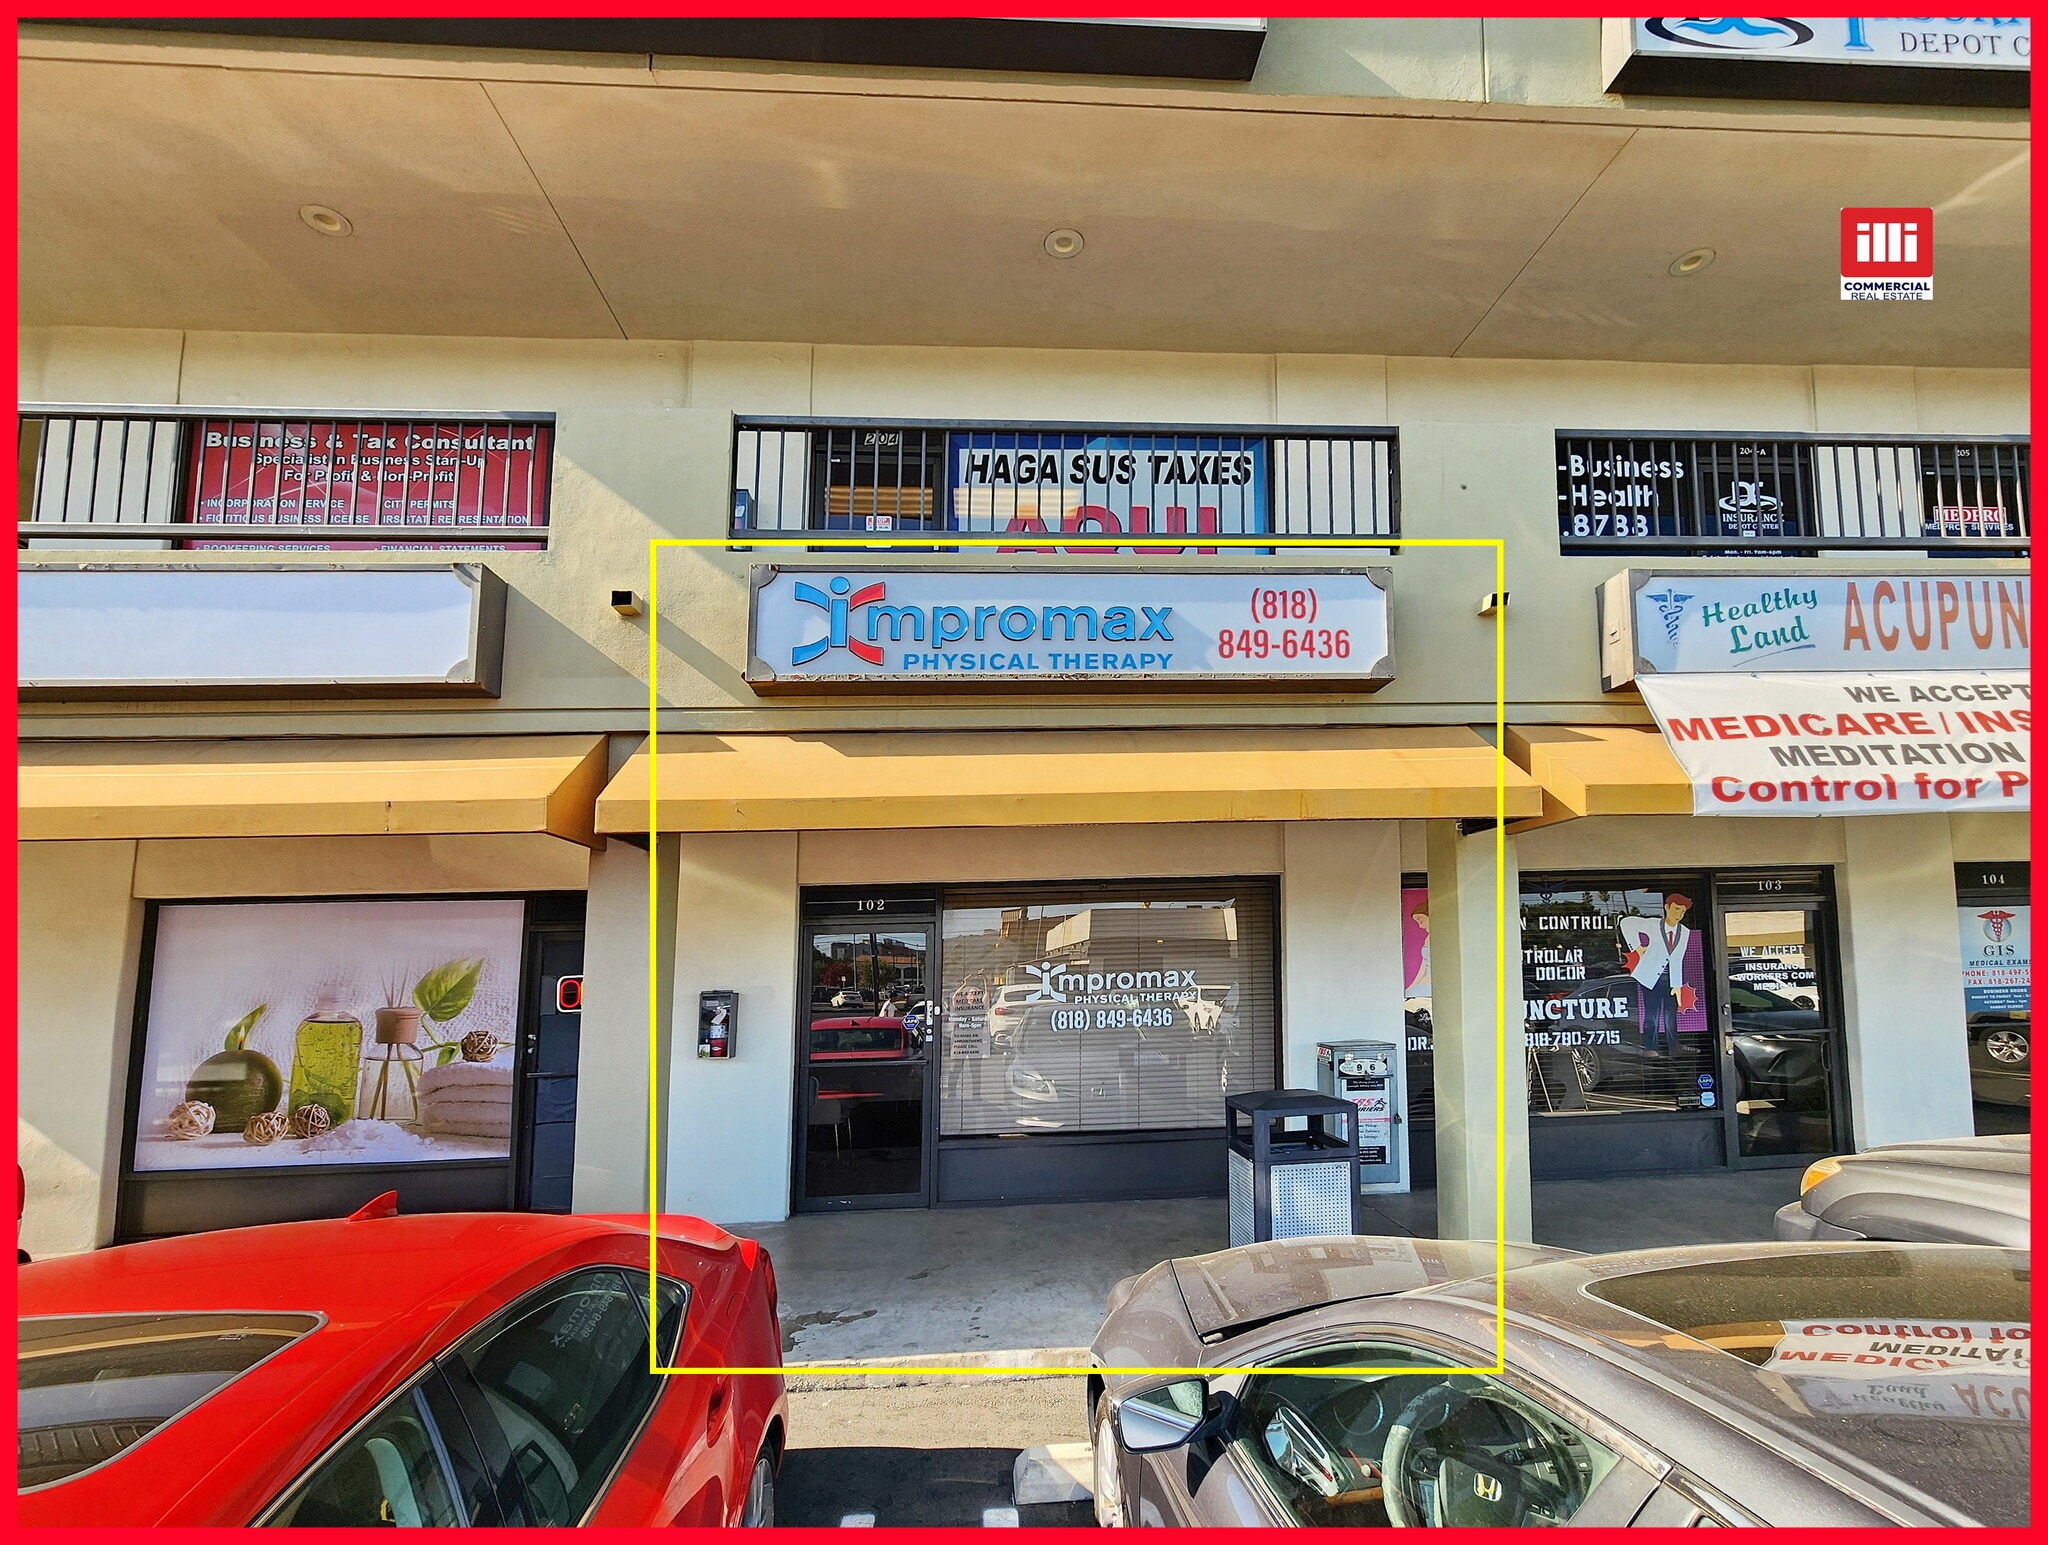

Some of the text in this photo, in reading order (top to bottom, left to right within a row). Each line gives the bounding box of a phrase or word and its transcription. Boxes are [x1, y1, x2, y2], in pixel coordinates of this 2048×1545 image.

[1900, 31, 2001, 55] DEPOT
[206, 432, 317, 449] Busness
[864, 433, 899, 446] 204
[256, 453, 327, 466] Speciaist
[1739, 447, 1766, 456] 20-A
[964, 453, 1252, 486] HAGA SUS TAXES
[1252, 587, 1318, 624] (818)
[1701, 580, 2029, 651] Healthy ACUPUN
[1730, 615, 1811, 654] Land
[1218, 629, 1351, 659] 849-6436
[903, 653, 1174, 670] PHYSICAL THERAPY
[1843, 686, 1901, 704] WE
[1666, 711, 1937, 742] MEDICARE
[1768, 741, 2027, 767] MEDITATION
[1711, 773, 1898, 803] Control
[1913, 772, 1983, 800] for
[1758, 880, 1782, 891] 103
[1982, 874, 2005, 885] 104
[857, 899, 885, 911] 102
[1983, 945, 2015, 957] GIS
[1075, 991, 1198, 1005] PHYSICAL THERAPY
[1051, 1008, 1173, 1031] (818) 849-6436
